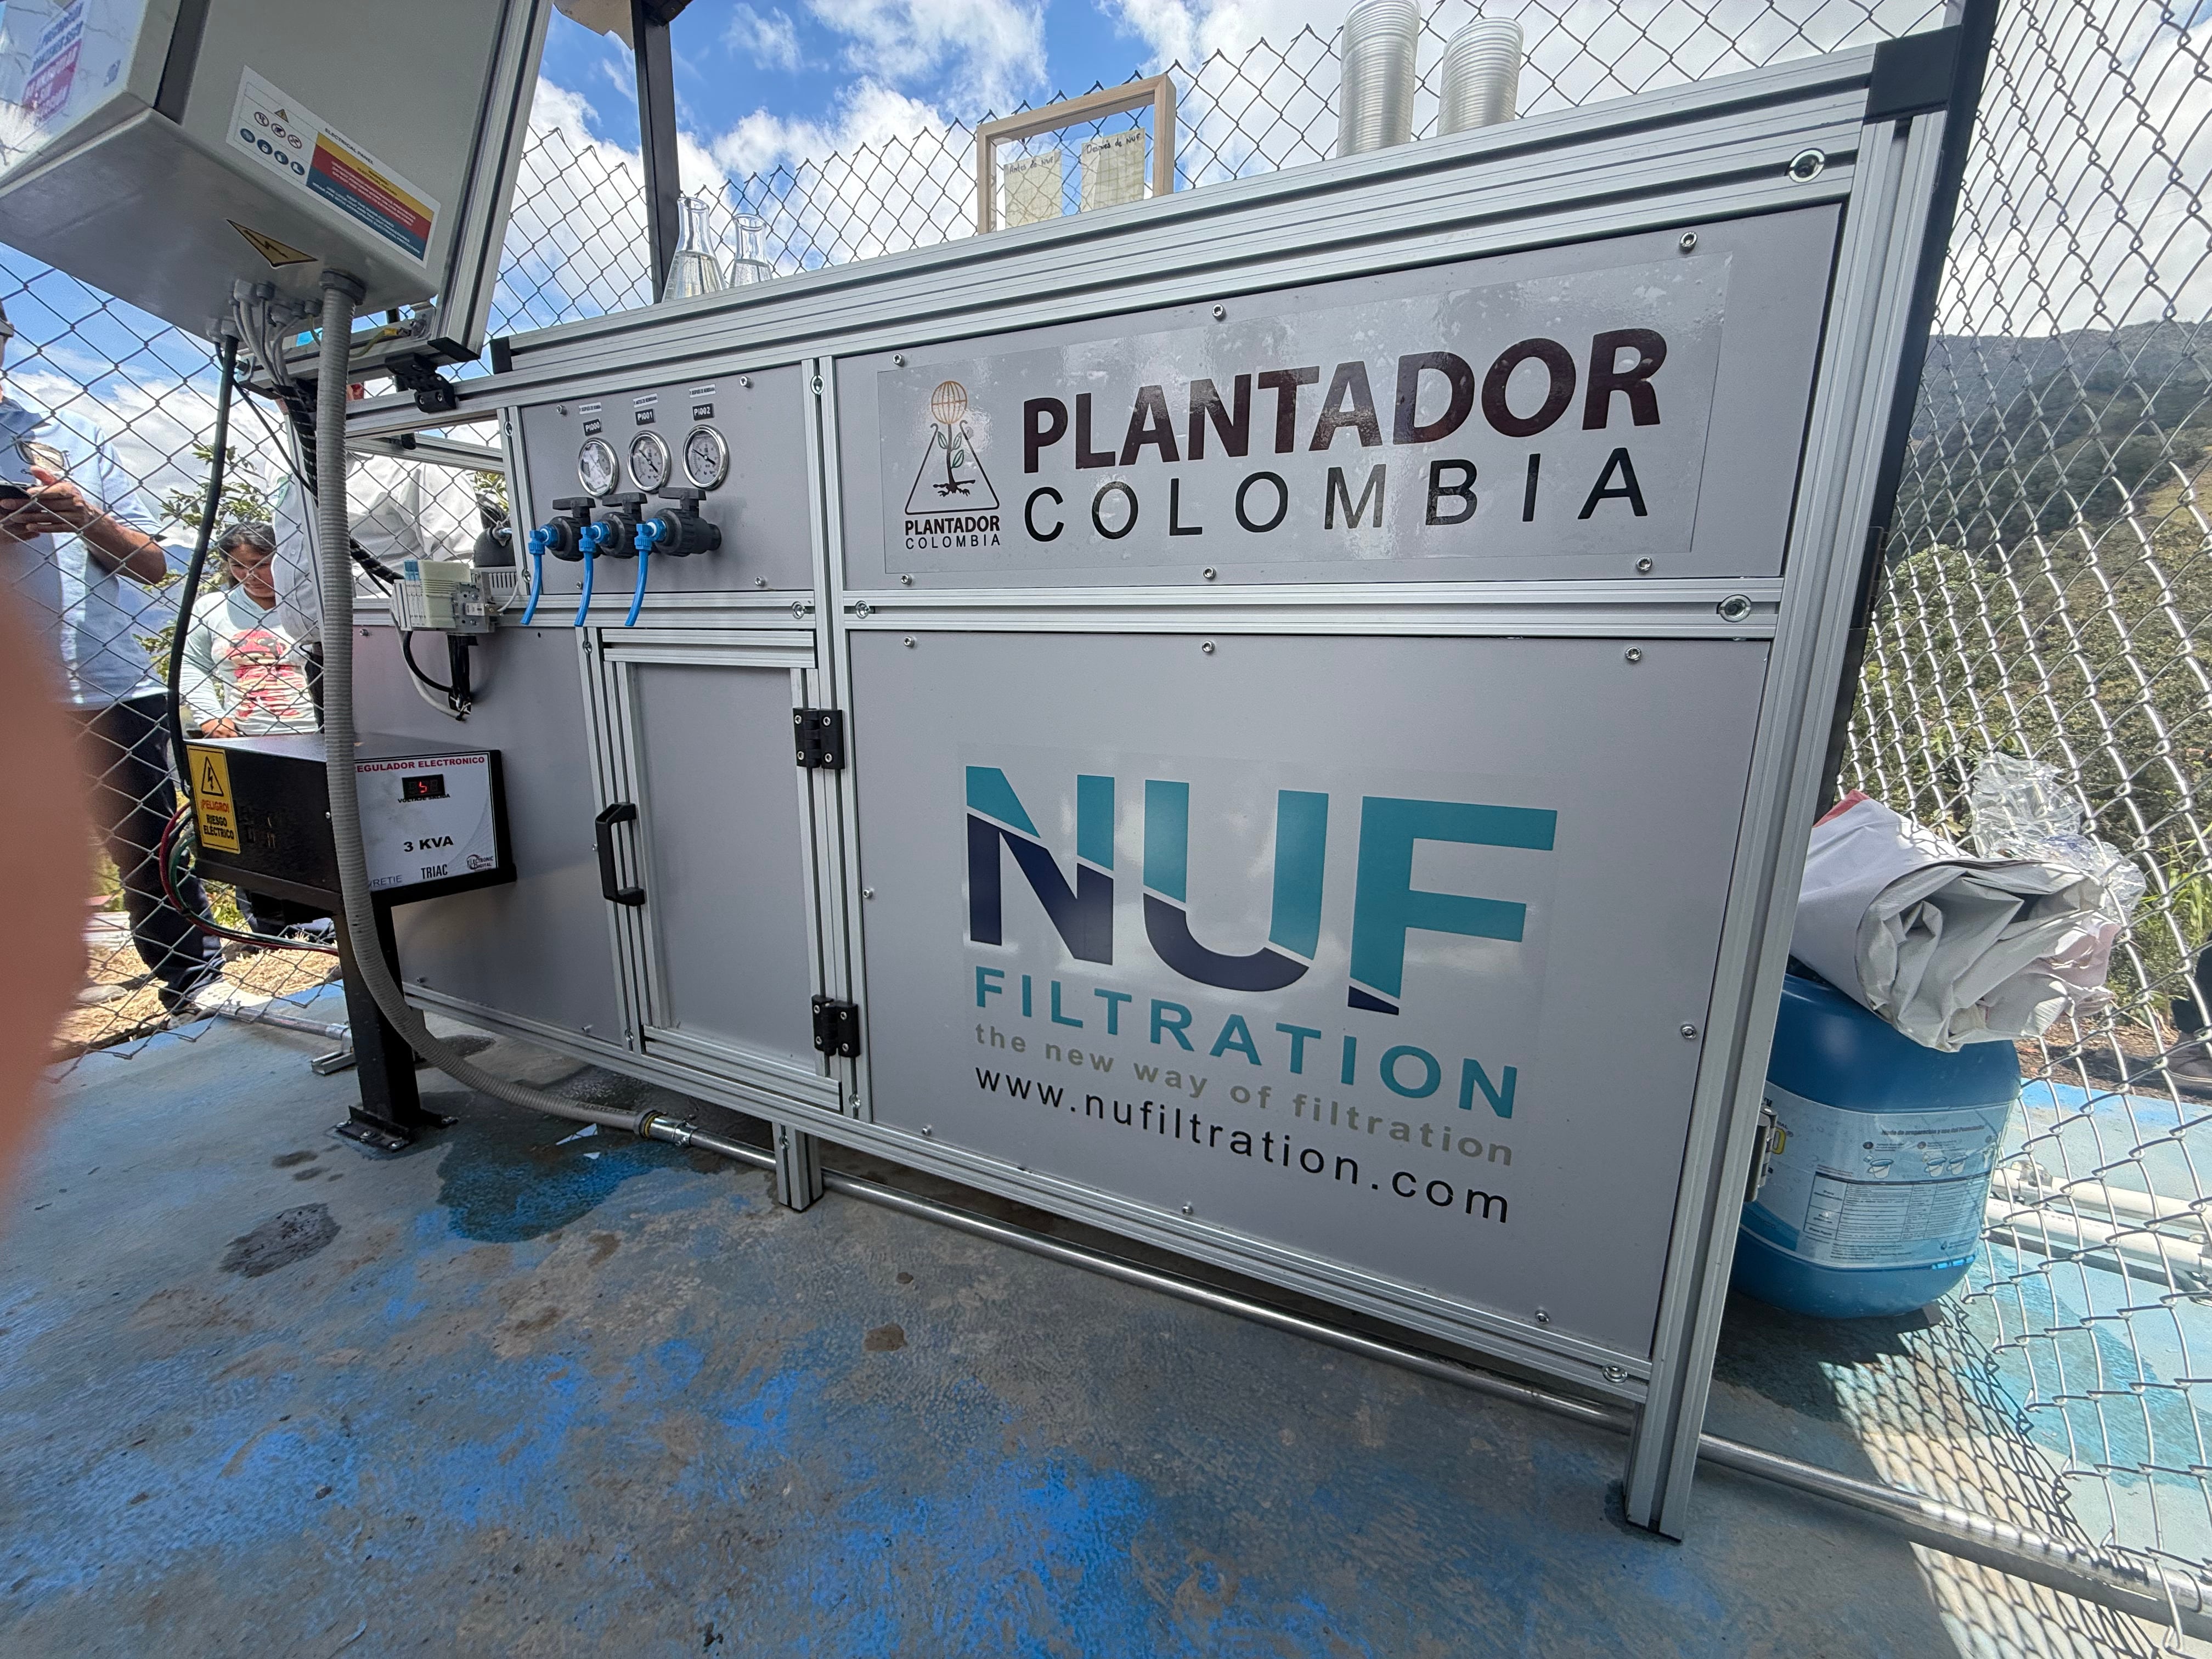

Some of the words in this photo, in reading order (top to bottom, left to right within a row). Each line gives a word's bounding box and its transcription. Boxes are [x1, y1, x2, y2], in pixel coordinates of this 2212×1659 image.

[324, 127, 357, 153] ELECTRICAL
[357, 150, 374, 165] PANEL
[1115, 138, 1122, 147] de
[1126, 133, 1141, 144] NUF
[1009, 163, 1027, 174] Antes
[1024, 328, 1667, 473] PLANTADOR
[637, 411, 653, 421] PI001
[693, 407, 710, 416] PI002
[585, 421, 600, 432] PI000
[1024, 447, 1648, 542] COLOMBIA
[905, 516, 1000, 535] PLANTADOR
[906, 533, 1001, 549] COLOMBIA
[356, 761, 415, 772] EGULADOR
[418, 757, 484, 768] ELECTRONICO
[206, 814, 227, 827] RIESGO
[203, 824, 234, 840] ELÉCTRICO
[404, 842, 414, 852] 3
[419, 836, 454, 850] KVA
[421, 864, 448, 879] TRIAC
[373, 875, 402, 887] RETIE
[966, 766, 1557, 1015] NUF
[976, 966, 1517, 1119] FILTRATION
[975, 1023, 1026, 1053] the
[1045, 1042, 1113, 1073] new
[1133, 1062, 1208, 1099] way
[1231, 1082, 1272, 1109] of
[1293, 1094, 1513, 1166] filtration
[975, 1066, 1508, 1223] www.nufiltration.com
